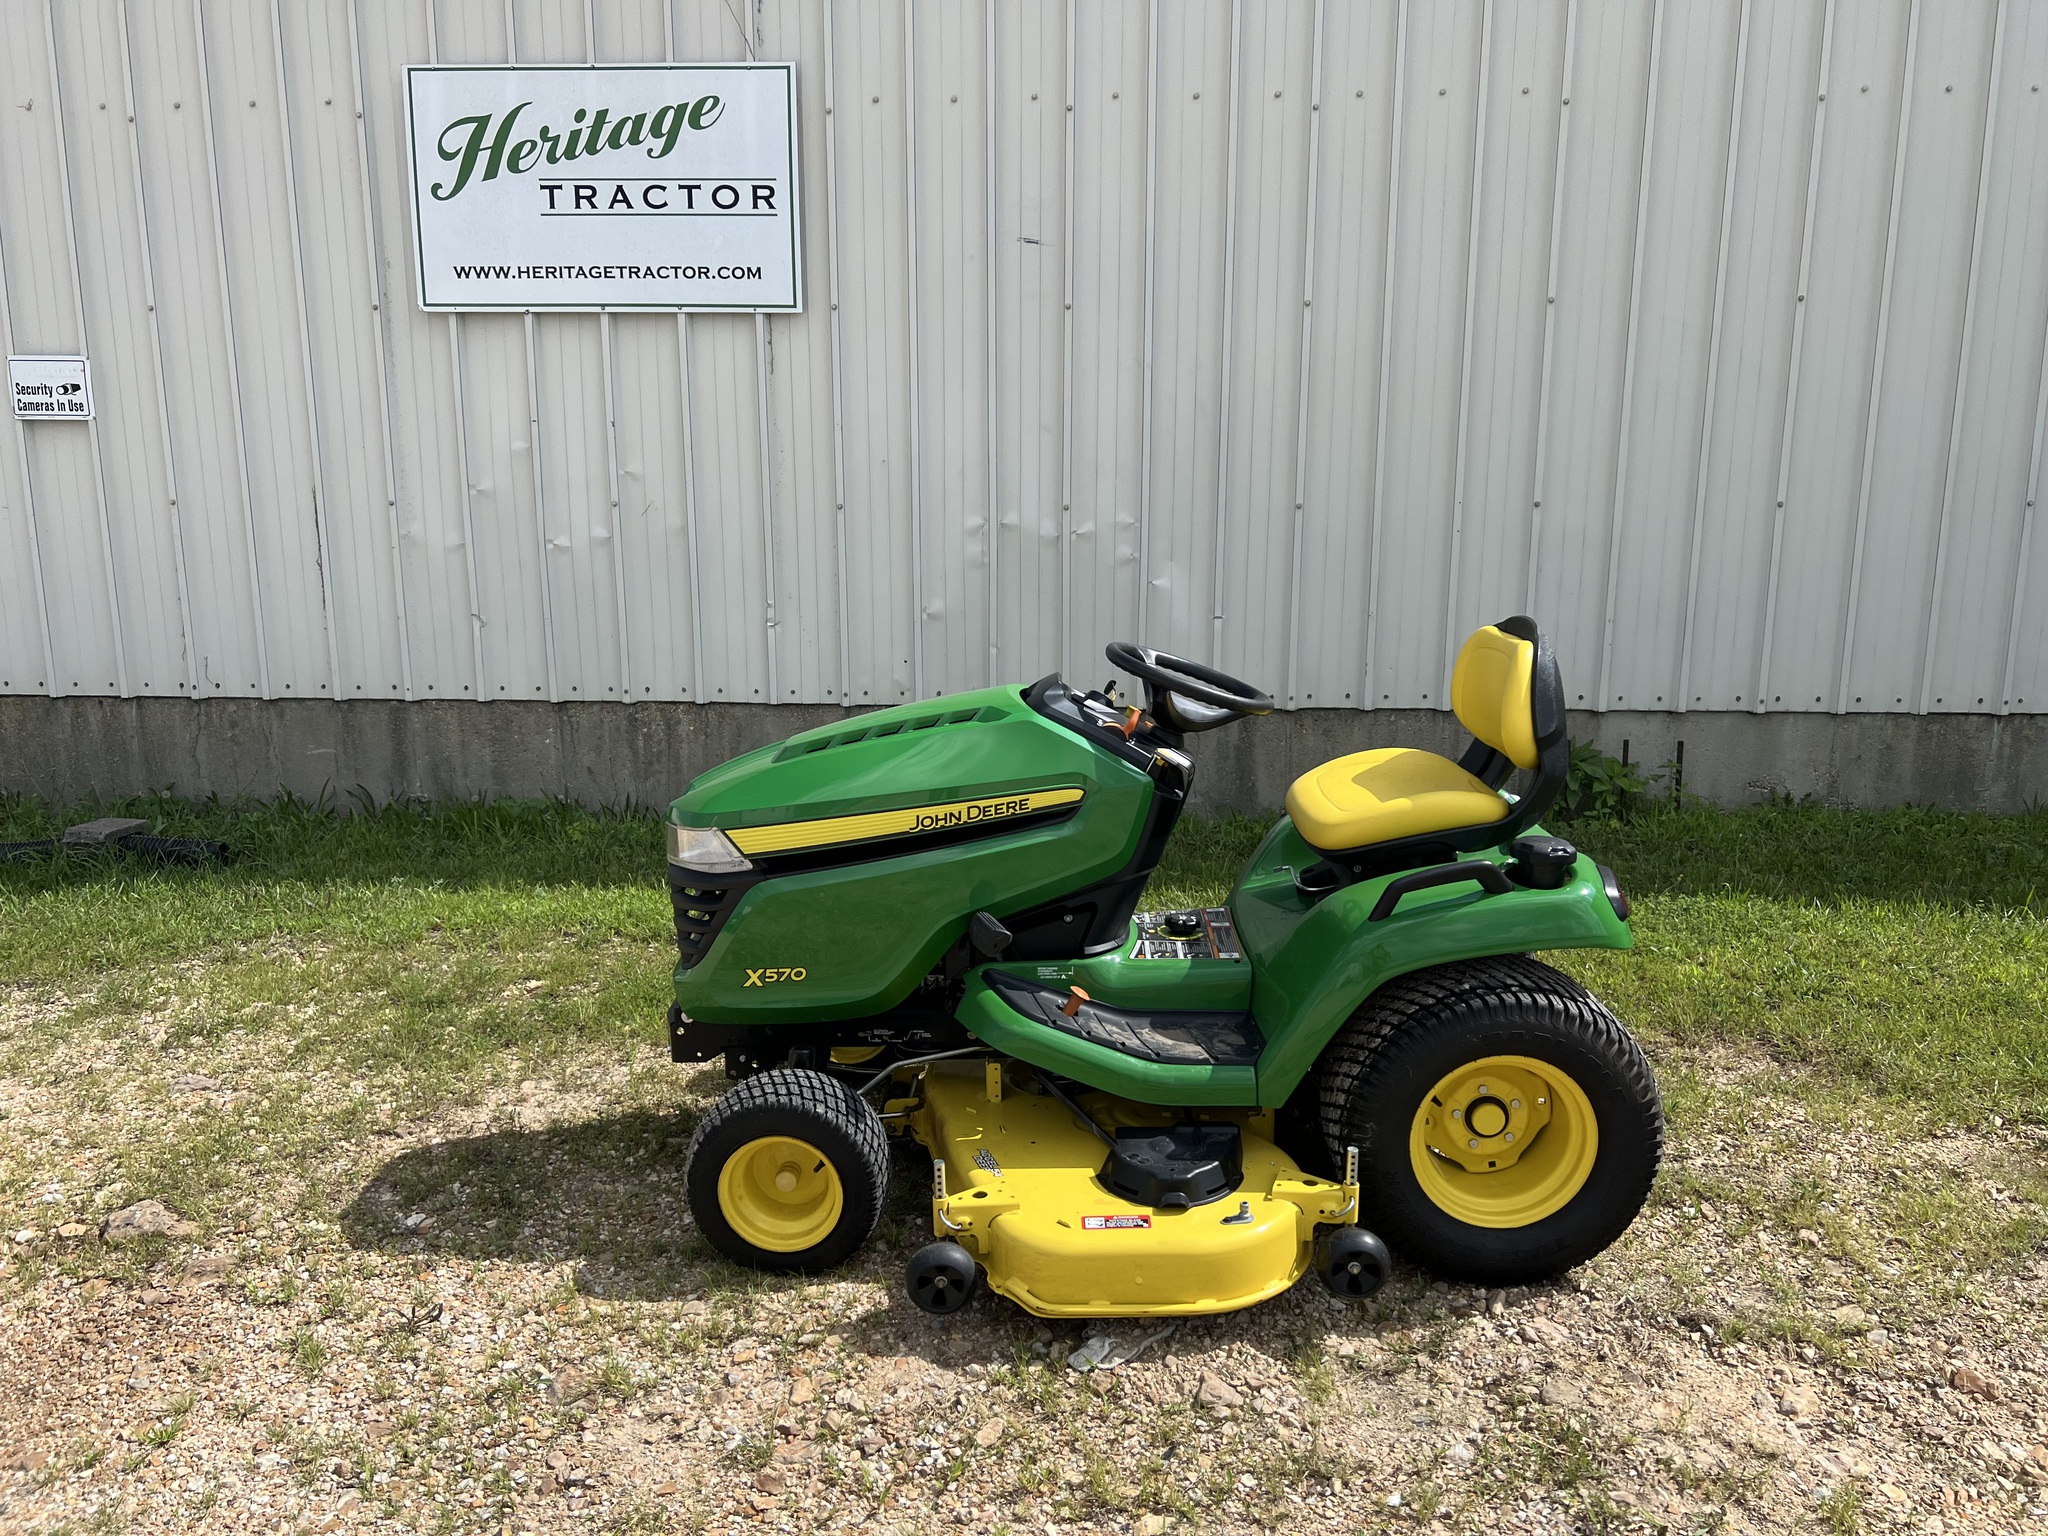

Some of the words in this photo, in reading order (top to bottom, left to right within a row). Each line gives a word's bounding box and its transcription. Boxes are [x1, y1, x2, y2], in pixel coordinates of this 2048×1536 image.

[430, 94, 726, 202] Heritage
[539, 183, 777, 210] TRACTOR
[452, 265, 763, 281] WWW.HERITAGETRACTOR.COM
[15, 382, 53, 398] Security
[17, 398, 55, 412] Cameras
[56, 399, 66, 412] In
[67, 399, 85, 412] Use
[908, 810, 962, 831] JOHN
[966, 798, 1031, 821] DEERE
[742, 967, 808, 987] X570
